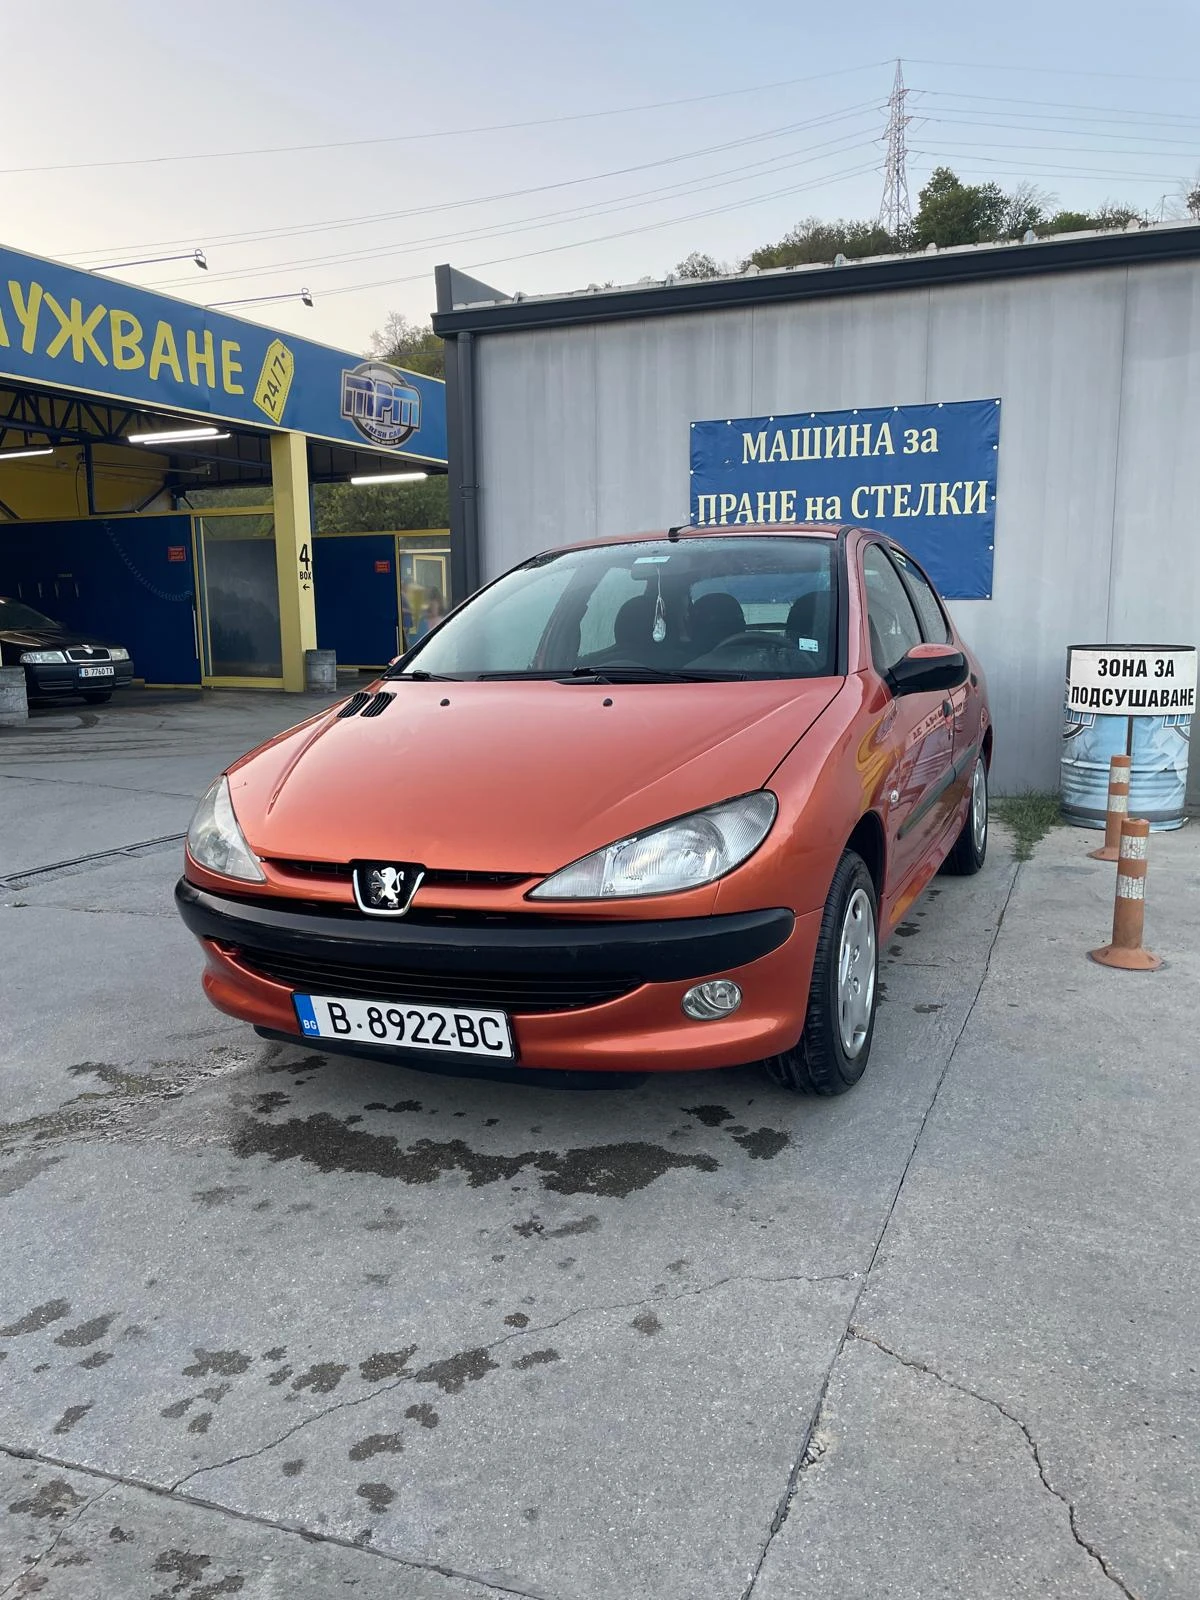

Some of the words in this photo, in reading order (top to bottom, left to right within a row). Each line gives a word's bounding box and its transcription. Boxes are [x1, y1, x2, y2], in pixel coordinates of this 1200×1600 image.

[263, 355, 286, 412] 24/7
[741, 422, 895, 464] МАШИНА
[903, 427, 939, 454] за
[697, 489, 797, 525] ПРАНЕ
[804, 495, 842, 521] на
[851, 480, 989, 519] СТЕЛКИ
[299, 543, 310, 571] 4
[299, 571, 312, 580] BOX
[1097, 658, 1148, 677] ЗОНА
[1154, 659, 1175, 677] ЗА
[1071, 686, 1195, 708] ПОДСУШАВАНЕ
[303, 1019, 317, 1030] BG
[366, 1006, 452, 1046] 8922
[453, 1013, 504, 1051] BC
